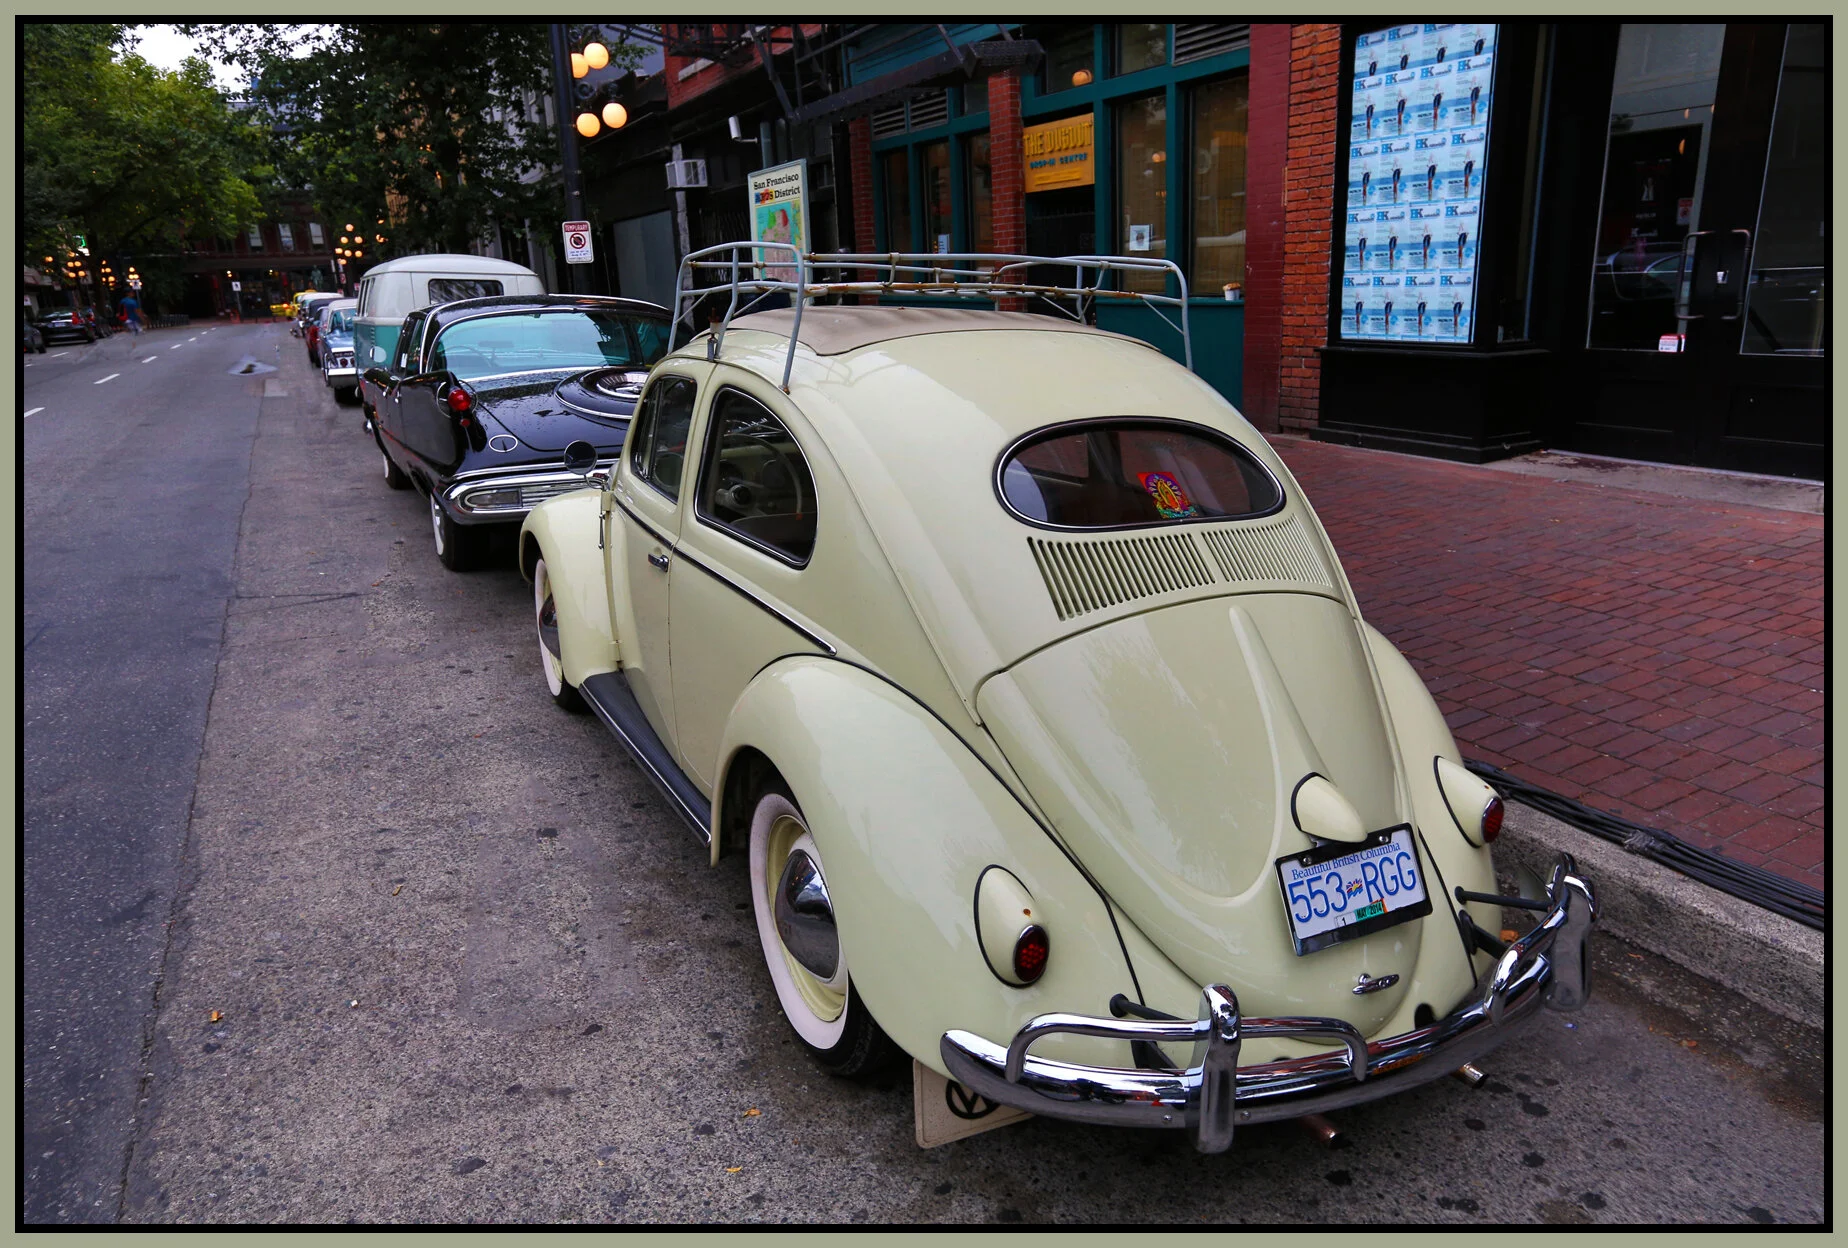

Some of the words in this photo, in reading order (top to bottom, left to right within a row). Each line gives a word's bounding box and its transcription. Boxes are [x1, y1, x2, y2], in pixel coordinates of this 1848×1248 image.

[1023, 132, 1044, 158] THE
[1046, 122, 1092, 153] DUGOUT
[1060, 152, 1088, 164] CENTRE
[753, 181, 766, 190] San
[766, 173, 800, 187] Francisco
[774, 185, 801, 199] District
[1292, 864, 1331, 880] Beautiful
[1333, 854, 1360, 869] British
[1360, 842, 1401, 861] Columbia
[1288, 872, 1348, 923] 553
[1361, 851, 1417, 903] RGG
[1356, 908, 1367, 919] MAY
[1369, 903, 1383, 915] 2014
